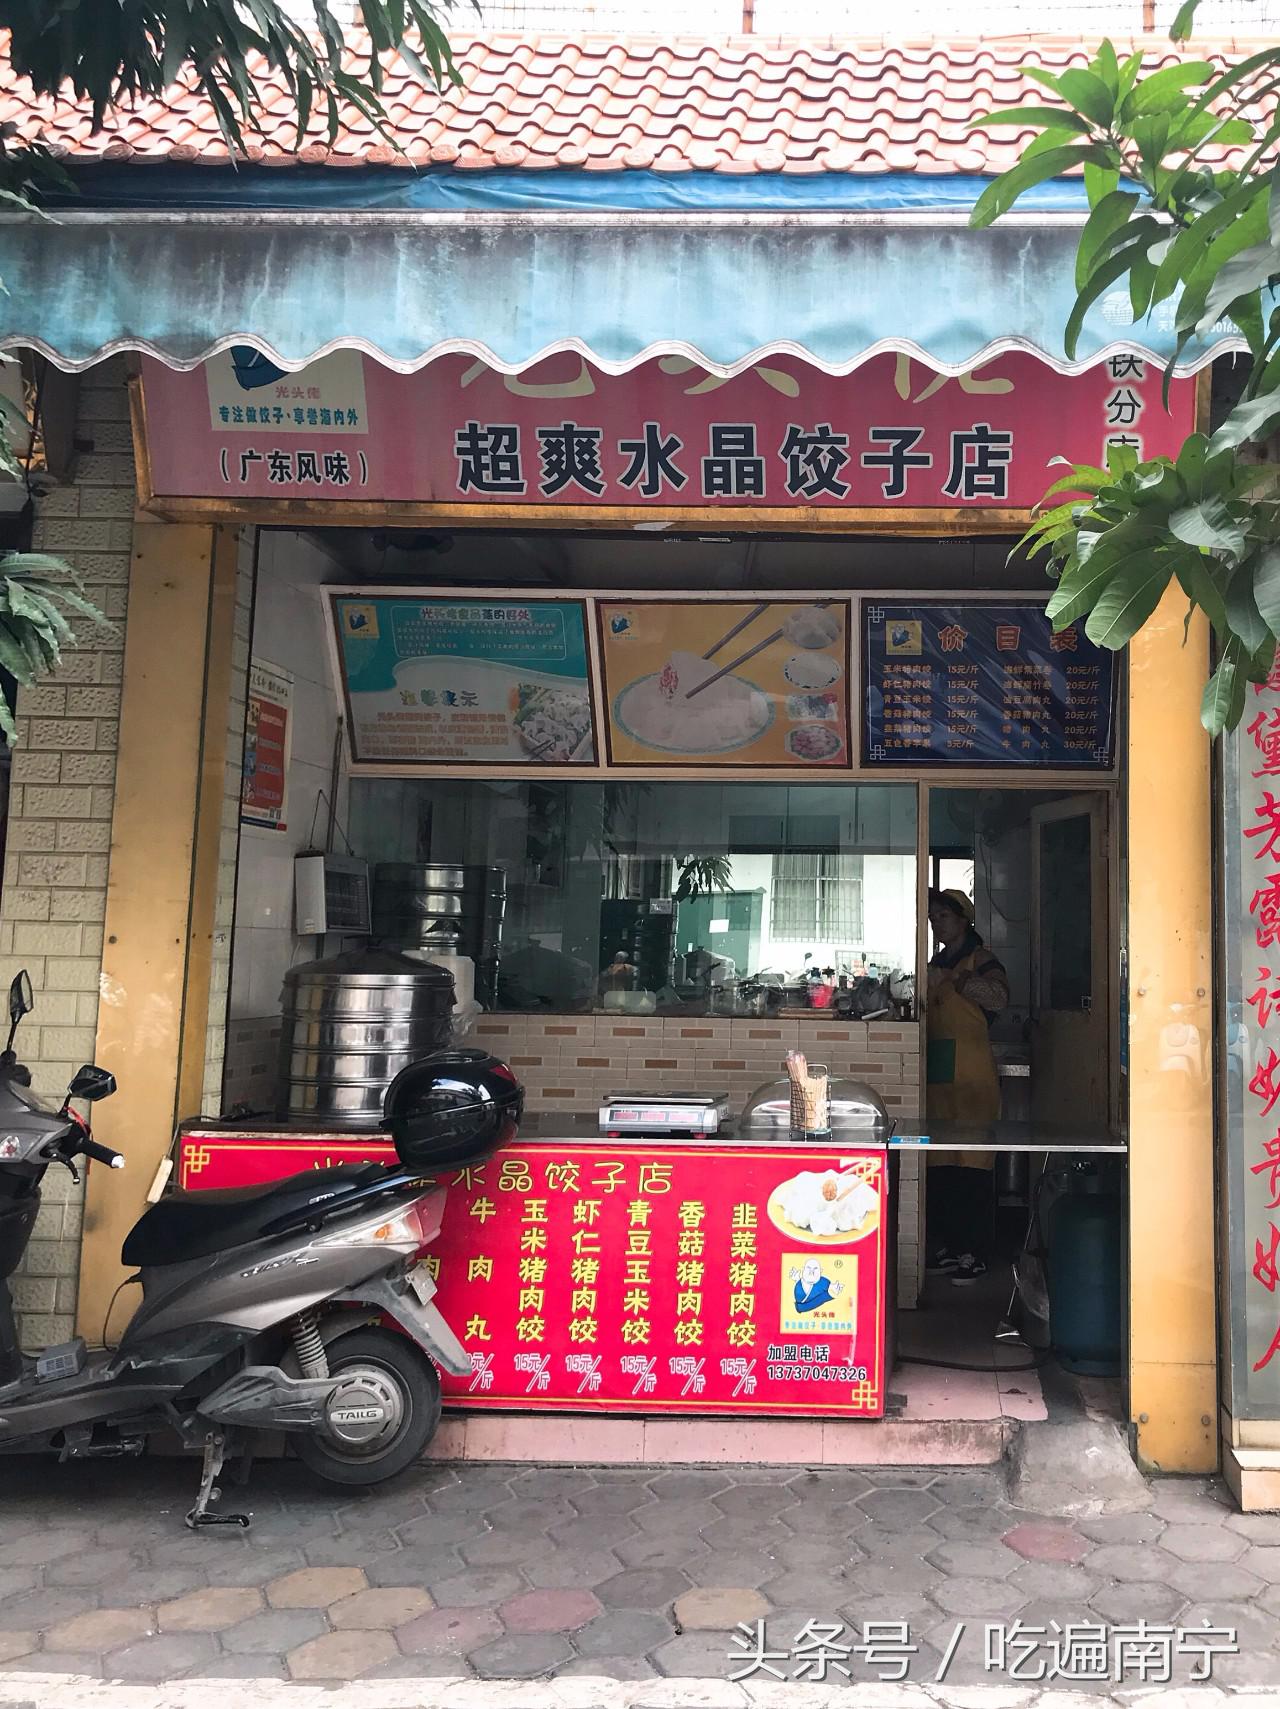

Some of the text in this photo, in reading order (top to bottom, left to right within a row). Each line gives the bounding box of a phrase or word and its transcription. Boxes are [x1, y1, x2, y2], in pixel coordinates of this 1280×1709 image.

[1108, 354, 1143, 468] 铁分
[455, 422, 1014, 502] 超爽水晶饺子店
[938, 624, 1078, 652] 价目表
[947, 664, 979, 673] 15元/斤
[1066, 665, 1100, 675] 20元/斤
[947, 680, 979, 689] 15元/斤
[1066, 680, 1099, 689] 20元/斤
[947, 695, 978, 704] 15元/斤
[1065, 696, 1099, 705] 20元/斤
[947, 709, 978, 719] 15元/斤
[1065, 711, 1098, 720] 20元/斤
[947, 725, 977, 734] 15元/斤
[1064, 725, 1097, 734] 20元/斤
[464, 1197, 497, 1341] 牛肉丸
[516, 1200, 549, 1342] 玉米猪肉饺
[568, 1200, 602, 1344] 虾仁猪肉饺
[620, 1200, 653, 1345] 青豆玉米饺
[674, 1202, 705, 1346] 香菇猪肉饺
[727, 1203, 758, 1347] 韭菜猪肉饺
[767, 1345, 830, 1362] 加盟电话
[767, 1366, 867, 1381] 13737047326
[337, 1409, 377, 1420] TAILG
